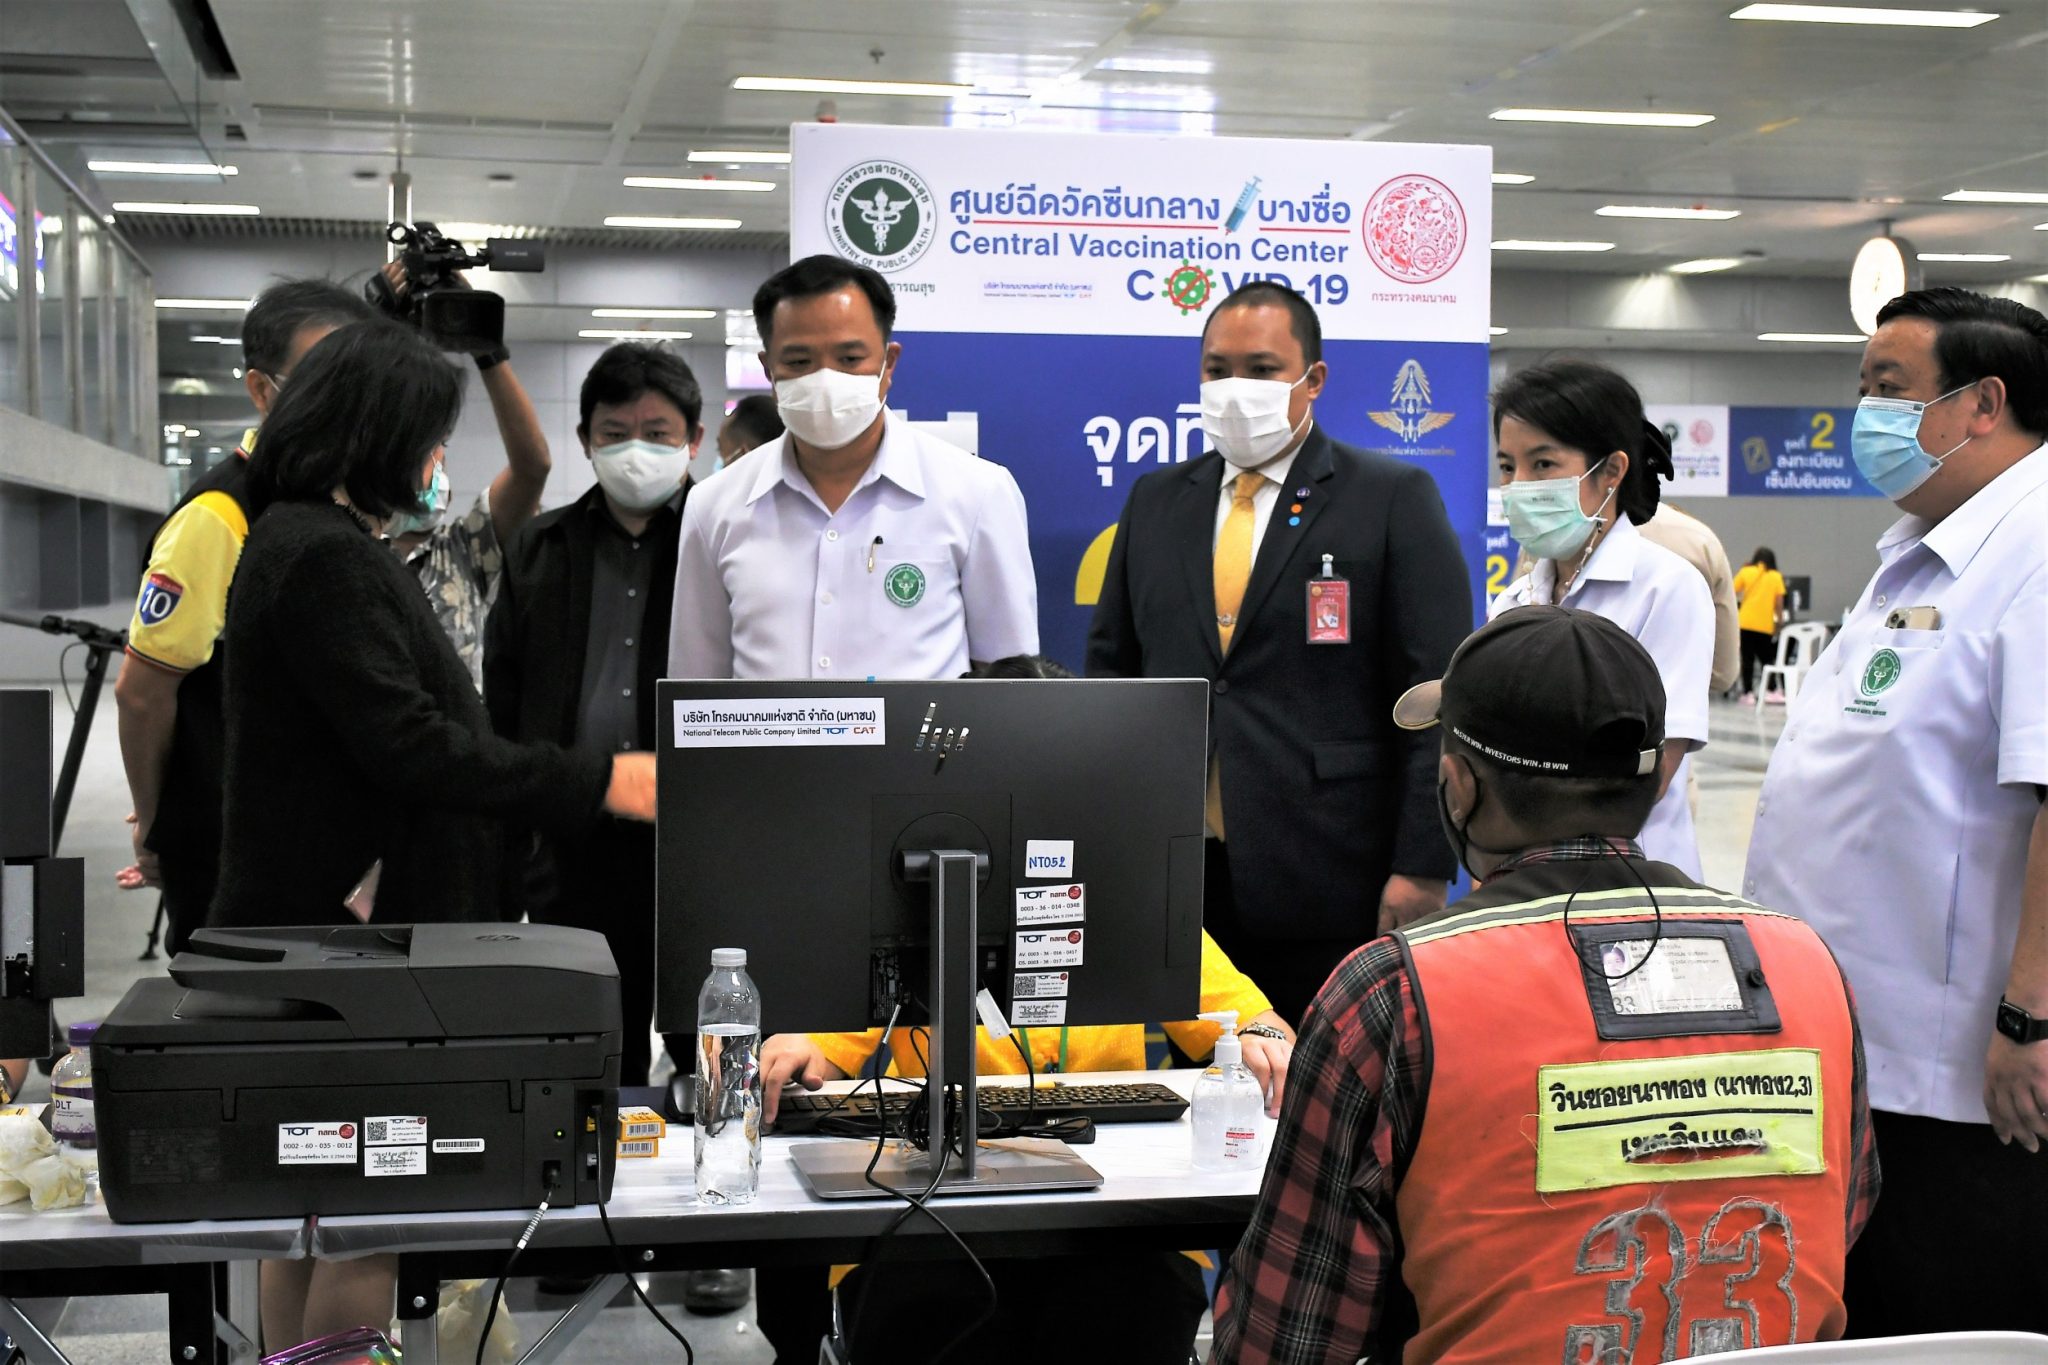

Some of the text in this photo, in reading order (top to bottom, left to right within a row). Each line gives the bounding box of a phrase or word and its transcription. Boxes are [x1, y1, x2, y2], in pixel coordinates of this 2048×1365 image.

[950, 183, 1351, 225] ศูนย์ฉีดวัคซีนกลาง บางซื่อ
[832, 225, 860, 260] MINISTRY
[876, 255, 908, 269] PUBLIC
[908, 228, 931, 258] HEALTH
[950, 230, 1349, 263] Central Vaccination Center
[1811, 411, 1835, 449] 2
[141, 587, 172, 619] 10
[683, 709, 876, 723] บริษัท โทรคมนาคมแห่งชาติ จำกัด (มหาชน)
[683, 729, 712, 737] National
[742, 728, 762, 736] Public
[764, 728, 796, 738] Company
[797, 727, 821, 735] Limited
[1484, 746, 1521, 764] INVESTORS
[1019, 890, 1047, 899] TOT
[1019, 934, 1047, 943] TOT
[1549, 1075, 1813, 1112] วินซอยนาทอง (นาทอง2,3)
[55, 1099, 72, 1111] DLT
[282, 1126, 314, 1136] TOT
[283, 1142, 300, 1150] 0002
